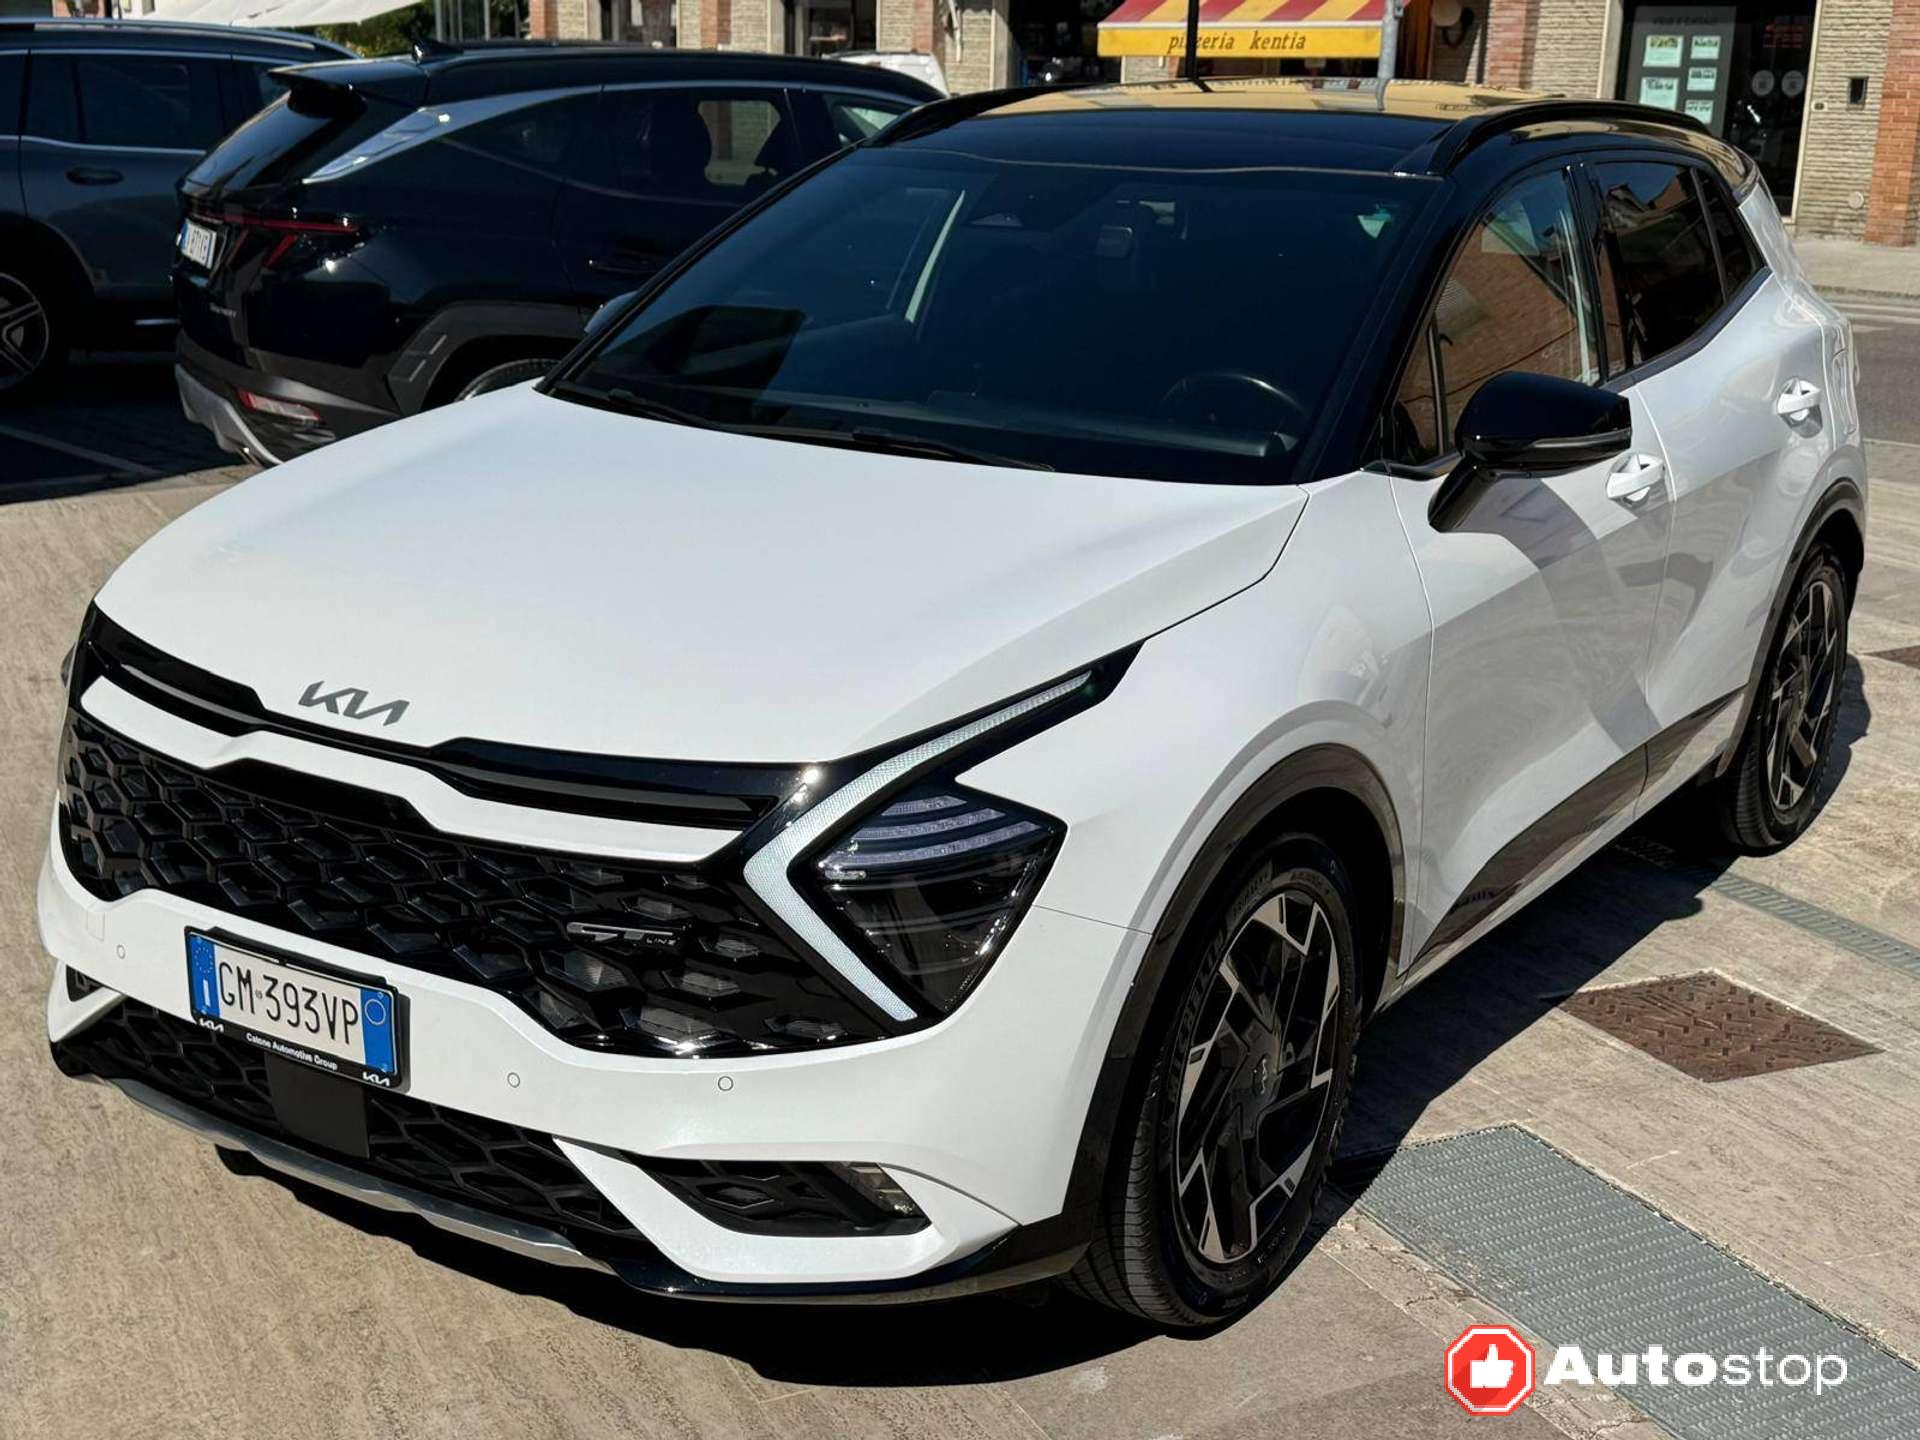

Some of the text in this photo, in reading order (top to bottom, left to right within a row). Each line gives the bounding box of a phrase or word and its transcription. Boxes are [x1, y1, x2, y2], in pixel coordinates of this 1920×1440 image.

[1249, 30, 1306, 50] kentia
[272, 1041, 314, 1063] Automotive
[313, 1054, 338, 1071] Group
